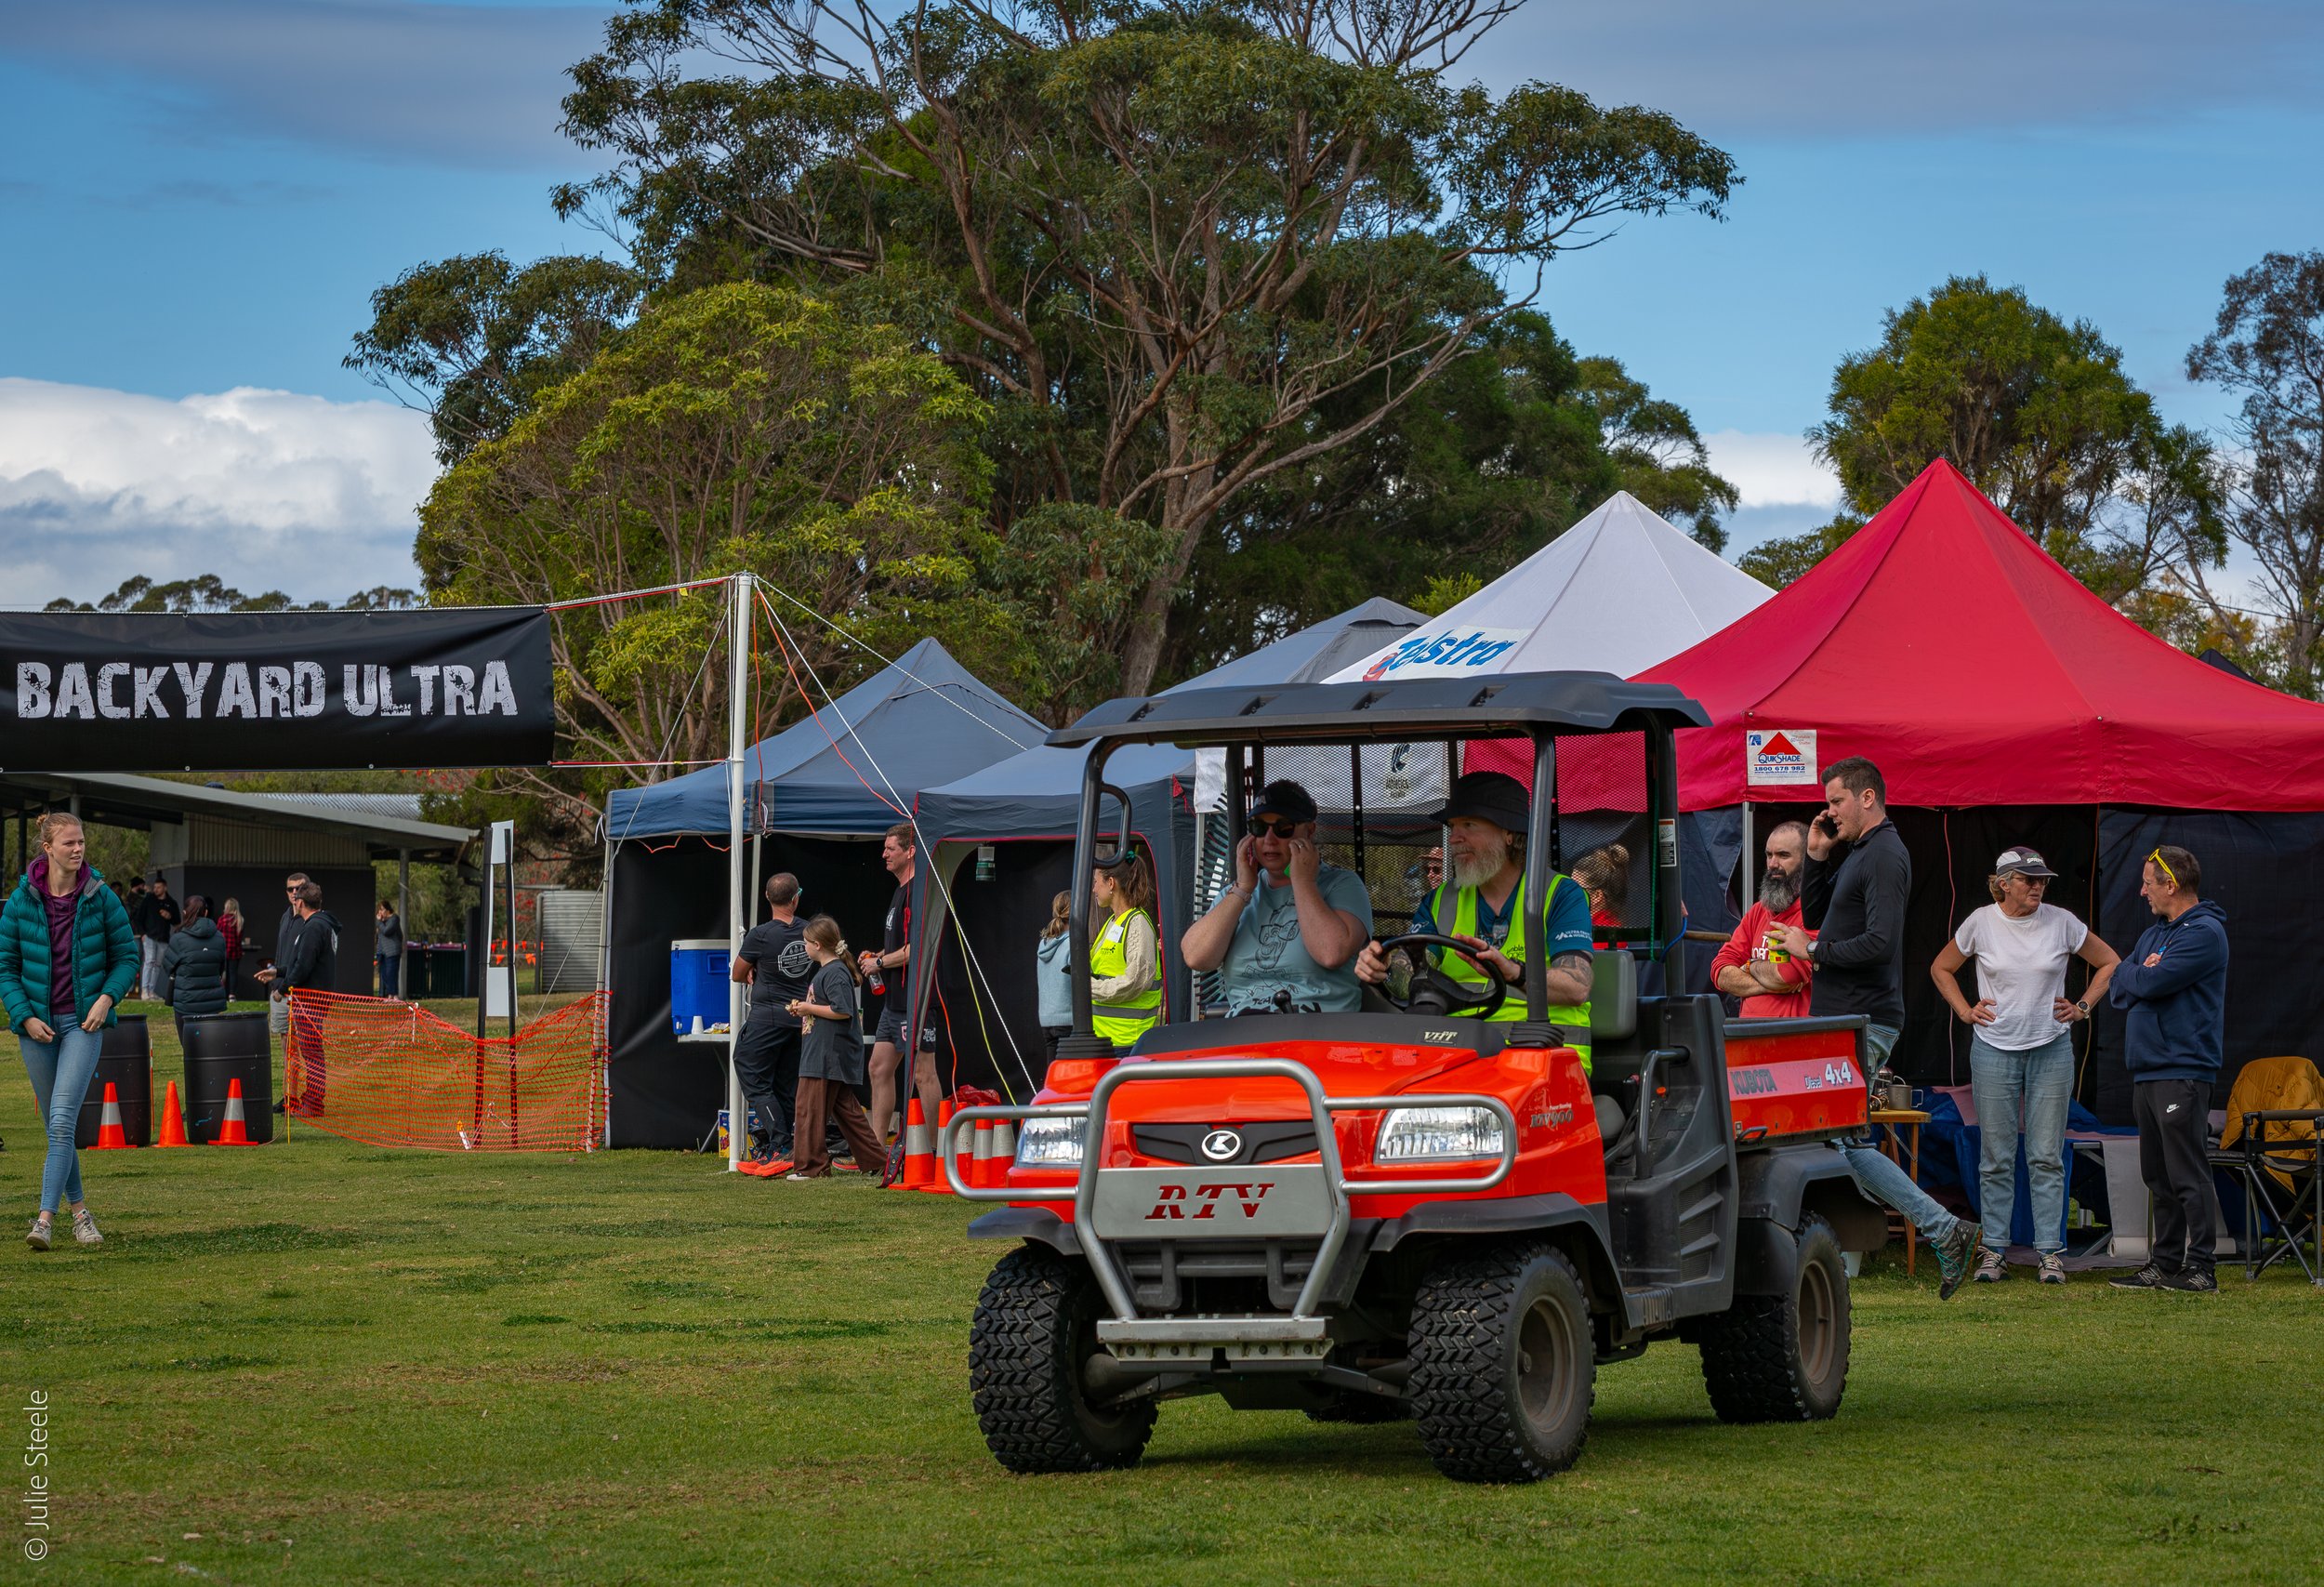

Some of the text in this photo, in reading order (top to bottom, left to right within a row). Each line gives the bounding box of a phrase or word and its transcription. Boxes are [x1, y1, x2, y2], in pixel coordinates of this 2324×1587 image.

[17, 660, 518, 719] BACKYARD ULTRA
[1252, 996, 1274, 1005] TEA
[1730, 1069, 1777, 1095] KUBOTA
[1804, 1061, 1853, 1090] Diesel 4x4
[1144, 1183, 1275, 1221] RTV
